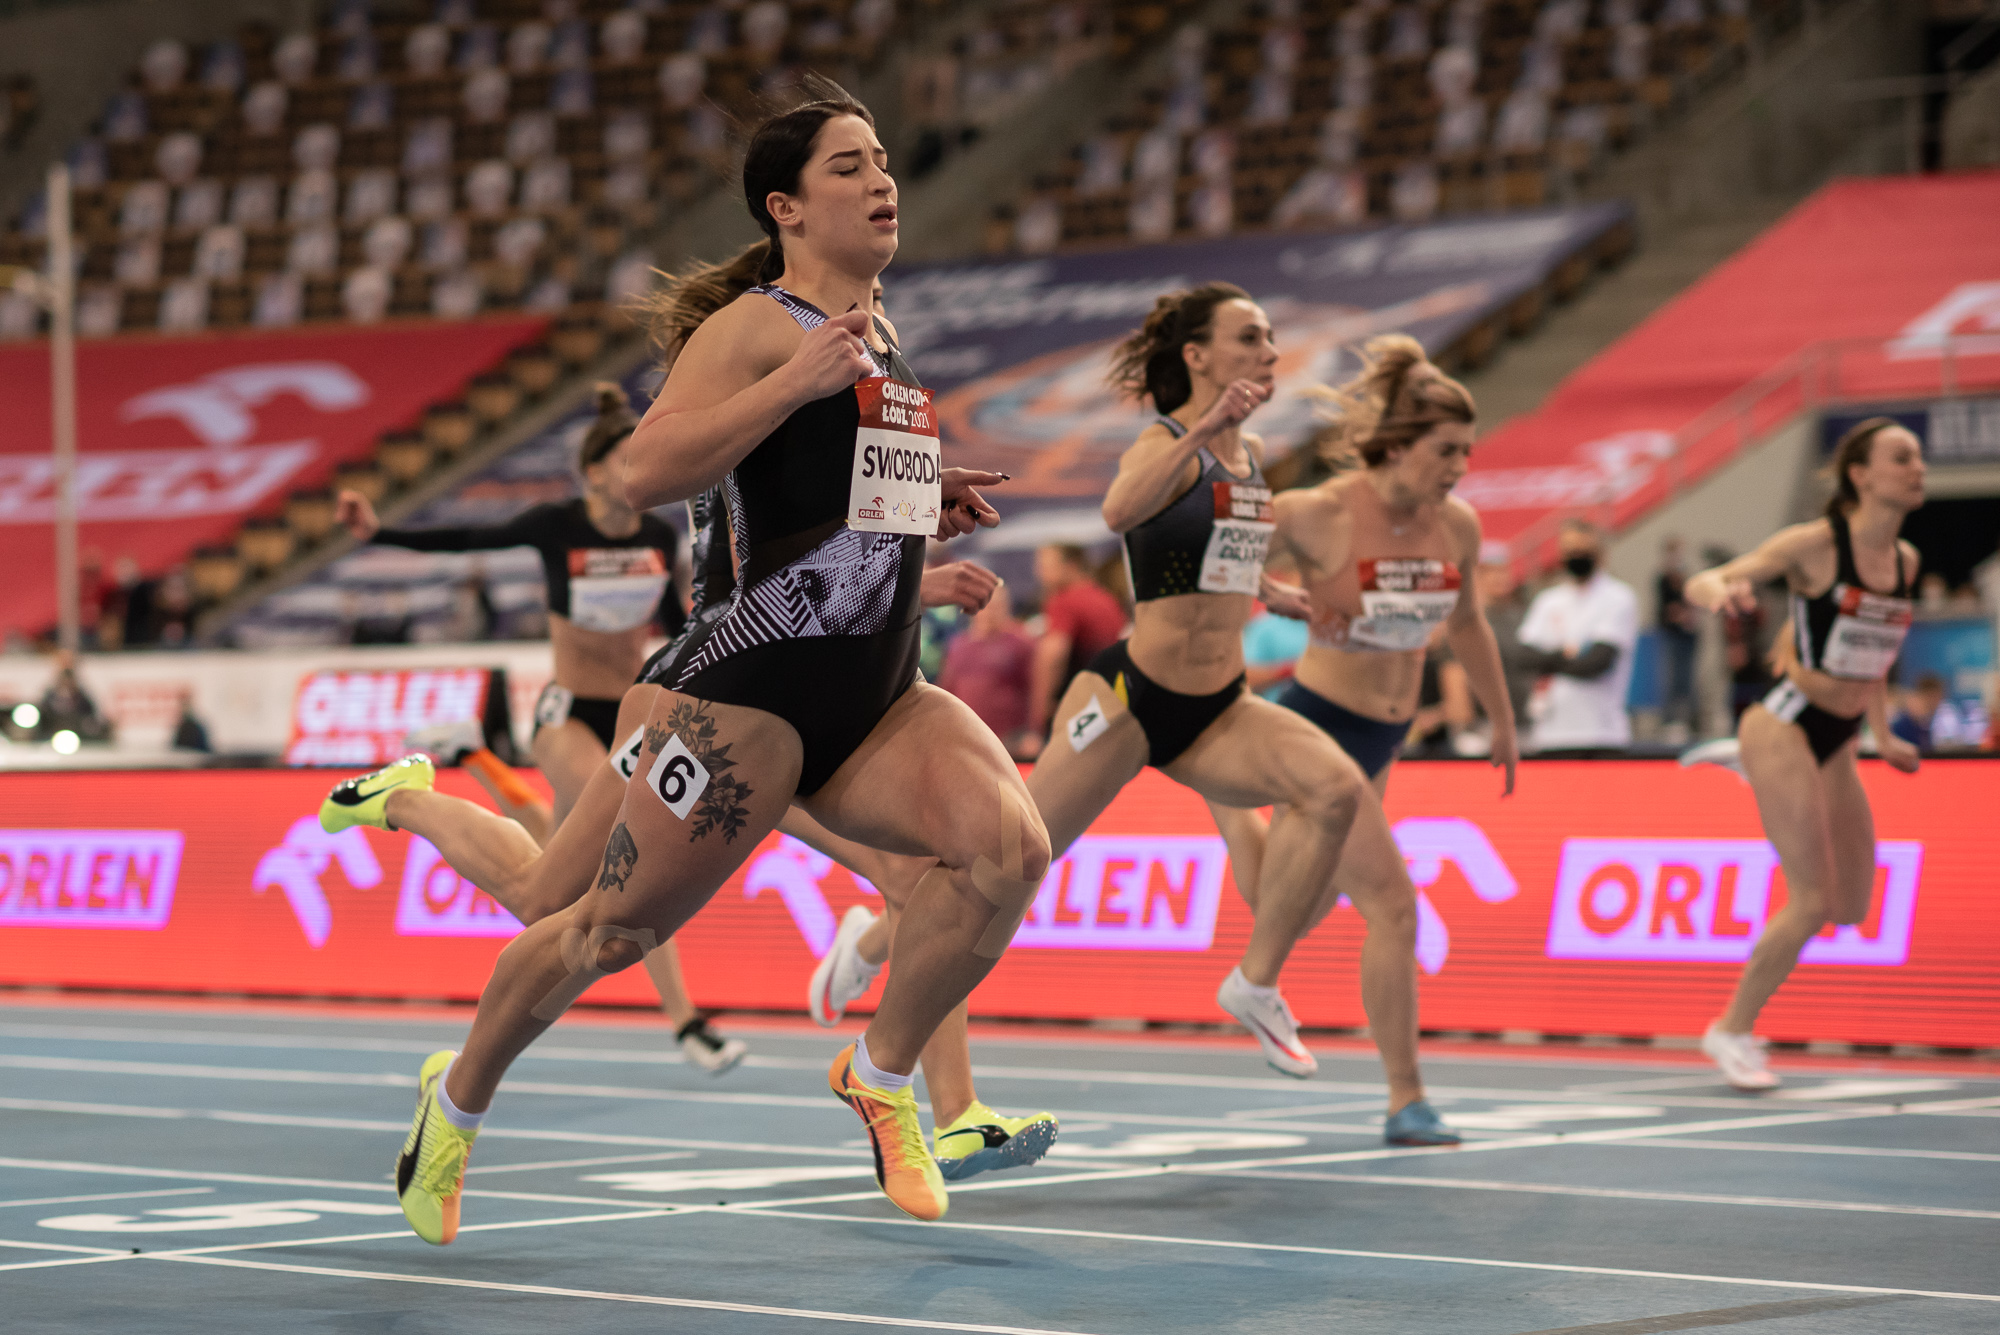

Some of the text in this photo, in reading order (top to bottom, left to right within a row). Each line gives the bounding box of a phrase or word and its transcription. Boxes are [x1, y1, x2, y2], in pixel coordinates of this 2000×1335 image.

[882, 381, 924, 407] ORLEN CUP
[882, 401, 930, 429] ŁÓDŹ 2021
[859, 510, 884, 519] ORLEN
[1073, 712, 1098, 738] 4
[658, 755, 696, 804] 6
[1024, 860, 1197, 925] LEN
